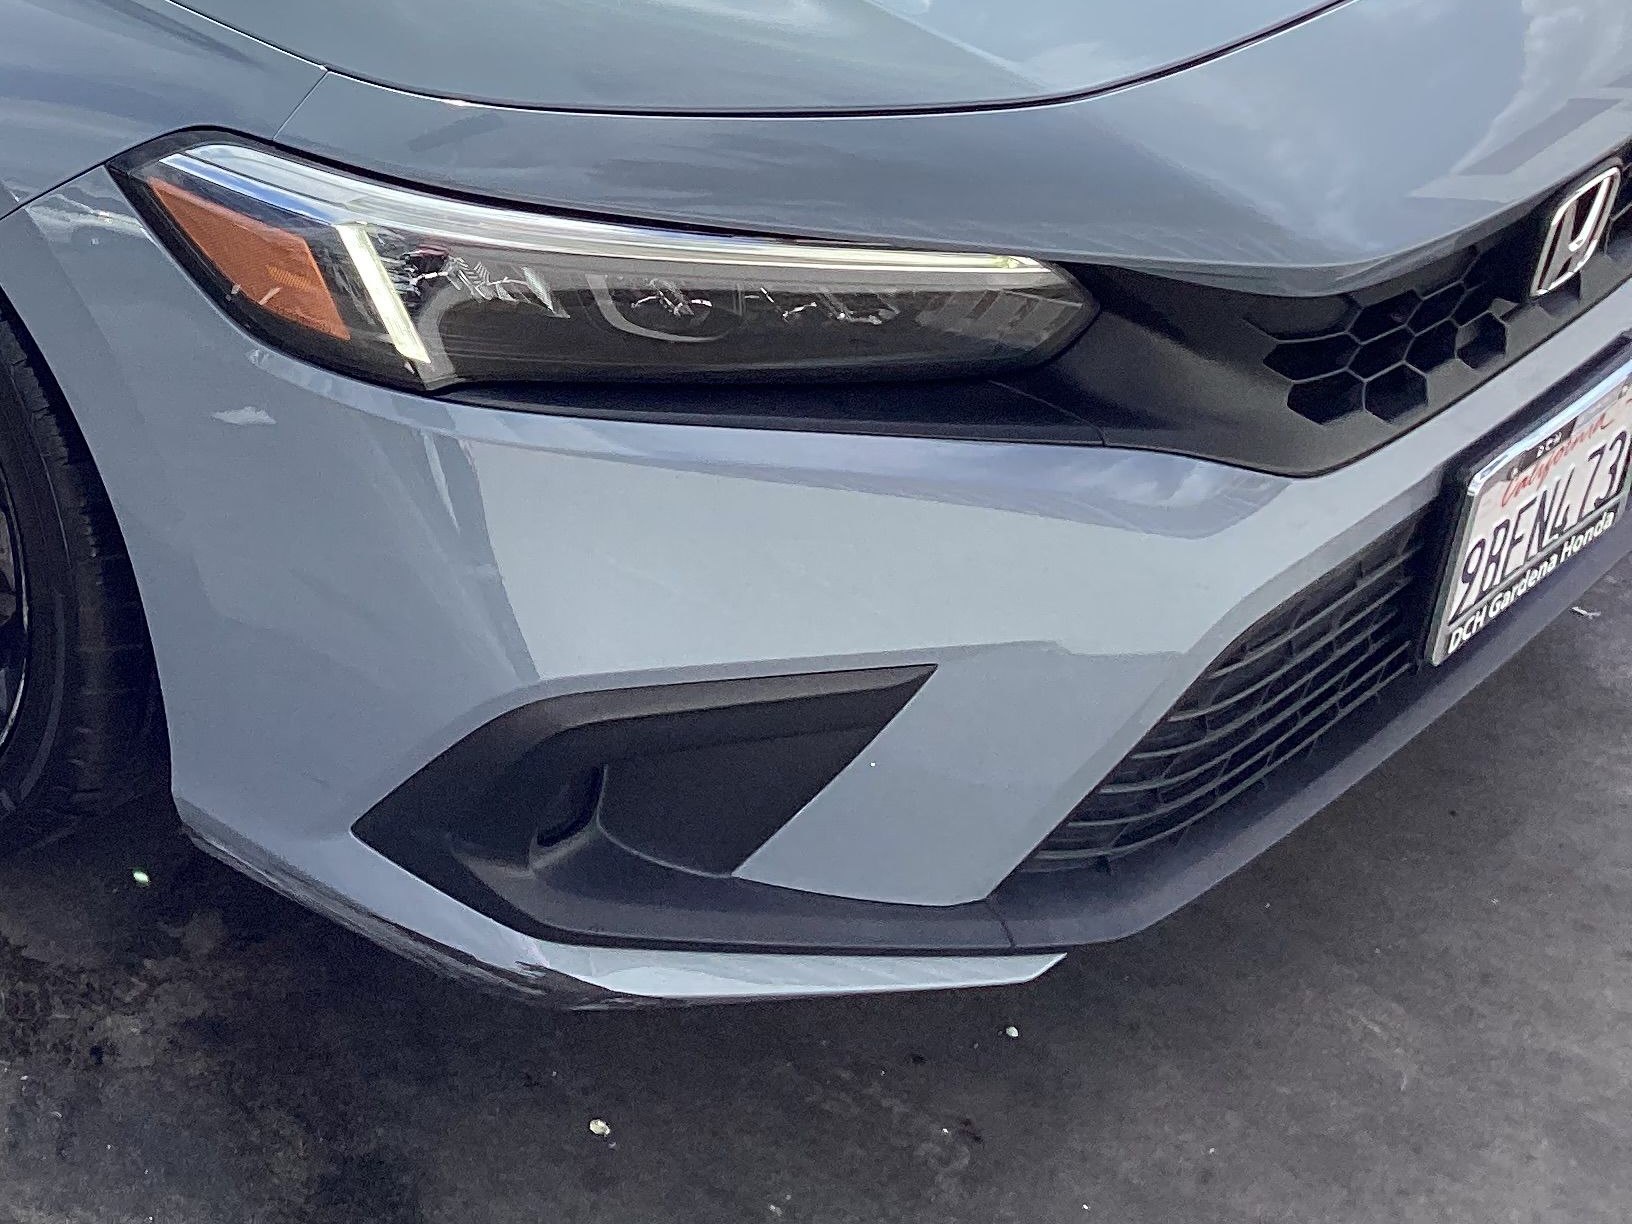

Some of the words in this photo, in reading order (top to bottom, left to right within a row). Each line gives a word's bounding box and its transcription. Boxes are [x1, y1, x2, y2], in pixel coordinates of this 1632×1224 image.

[1501, 412, 1615, 508] California
[1447, 604, 1489, 654] DCH
[1488, 552, 1558, 618] Gardena
[1560, 509, 1615, 564] Honda
